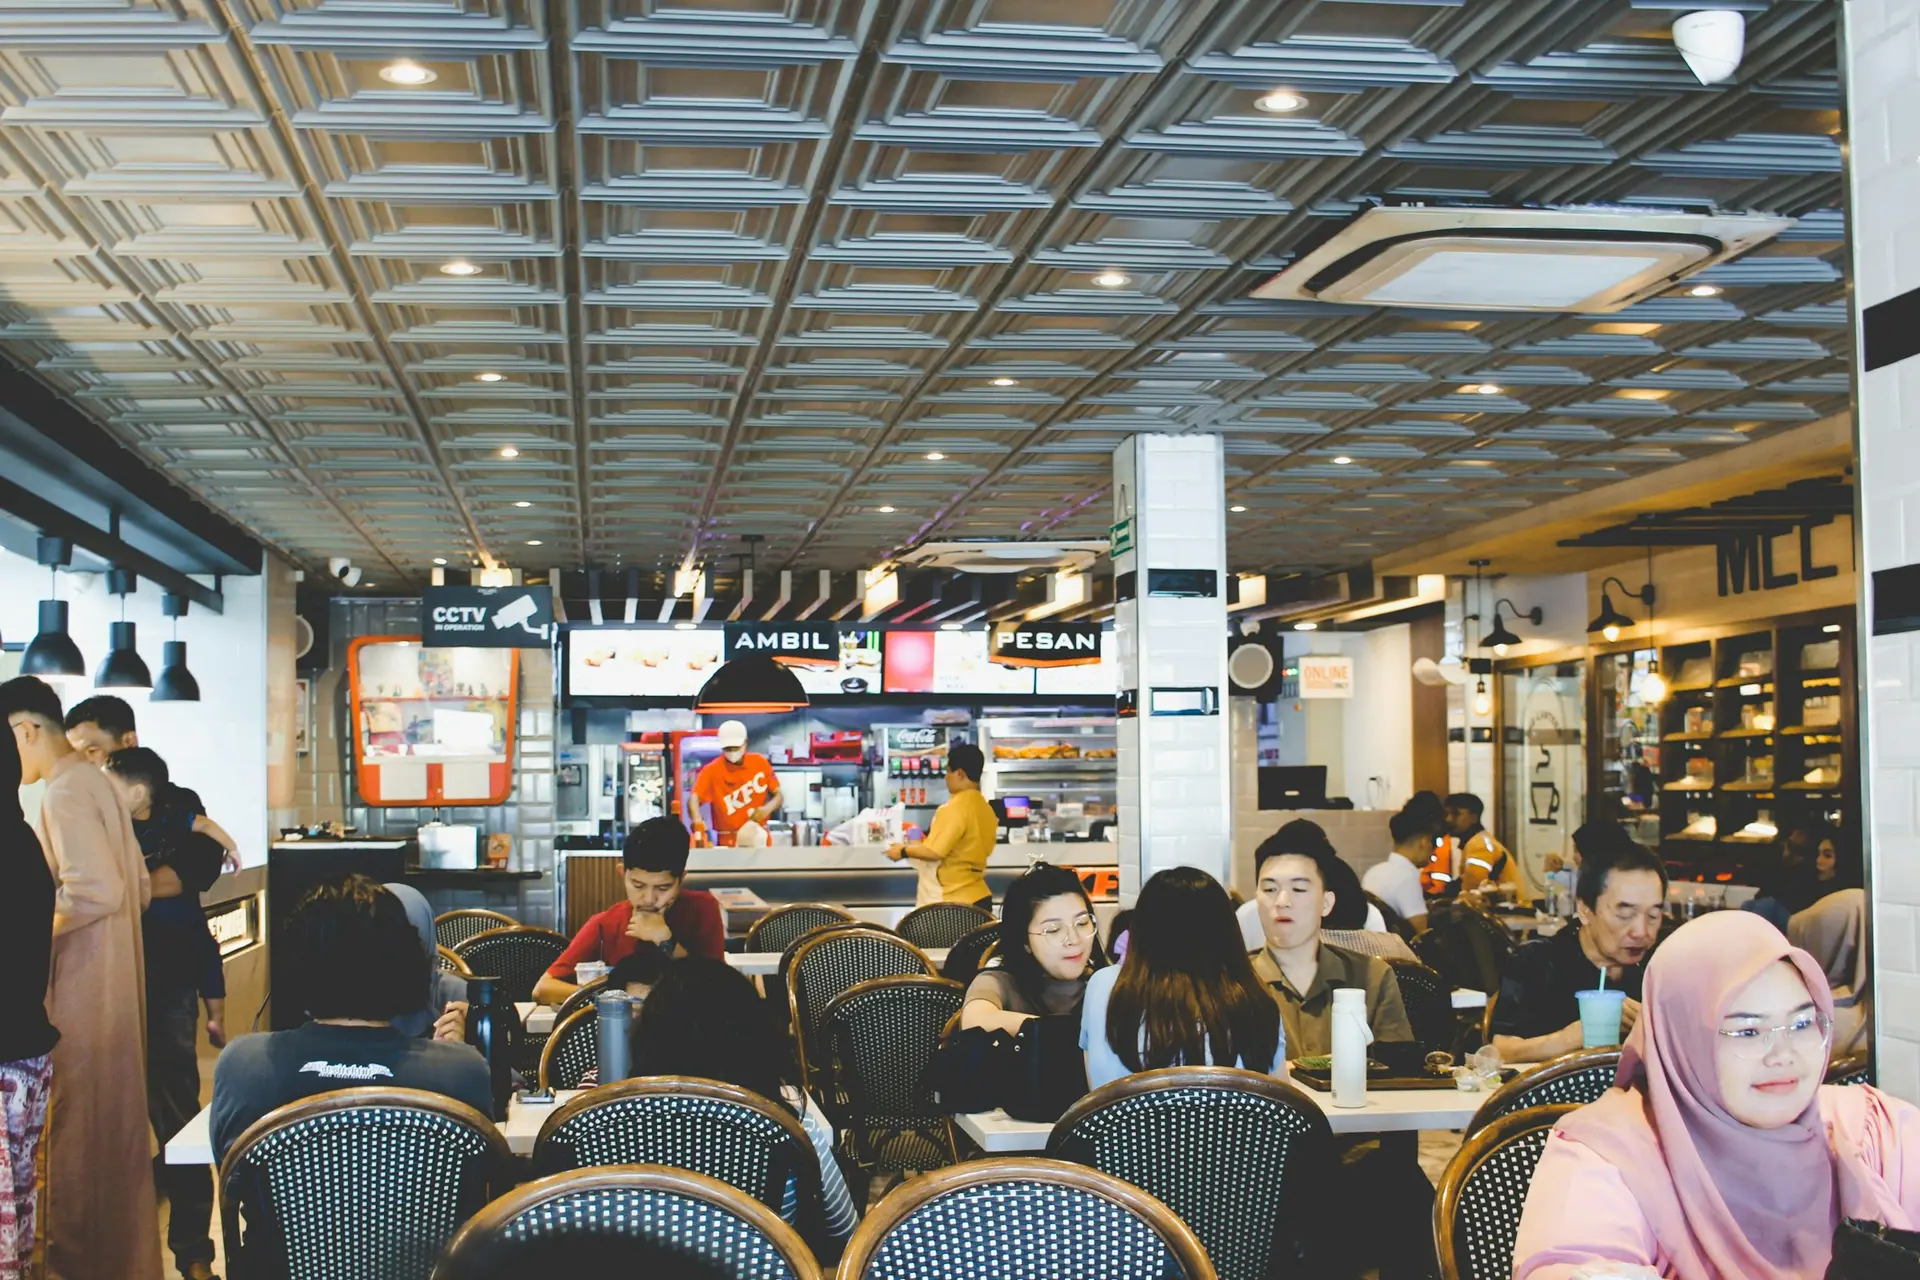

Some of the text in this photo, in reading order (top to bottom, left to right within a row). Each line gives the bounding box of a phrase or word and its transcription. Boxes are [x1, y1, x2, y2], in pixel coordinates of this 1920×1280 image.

[433, 606, 487, 623] CCTV
[734, 631, 830, 650] AMBIL
[996, 631, 1095, 650] PESAN
[1303, 665, 1349, 679] ONLINE
[723, 771, 768, 816] KFC
